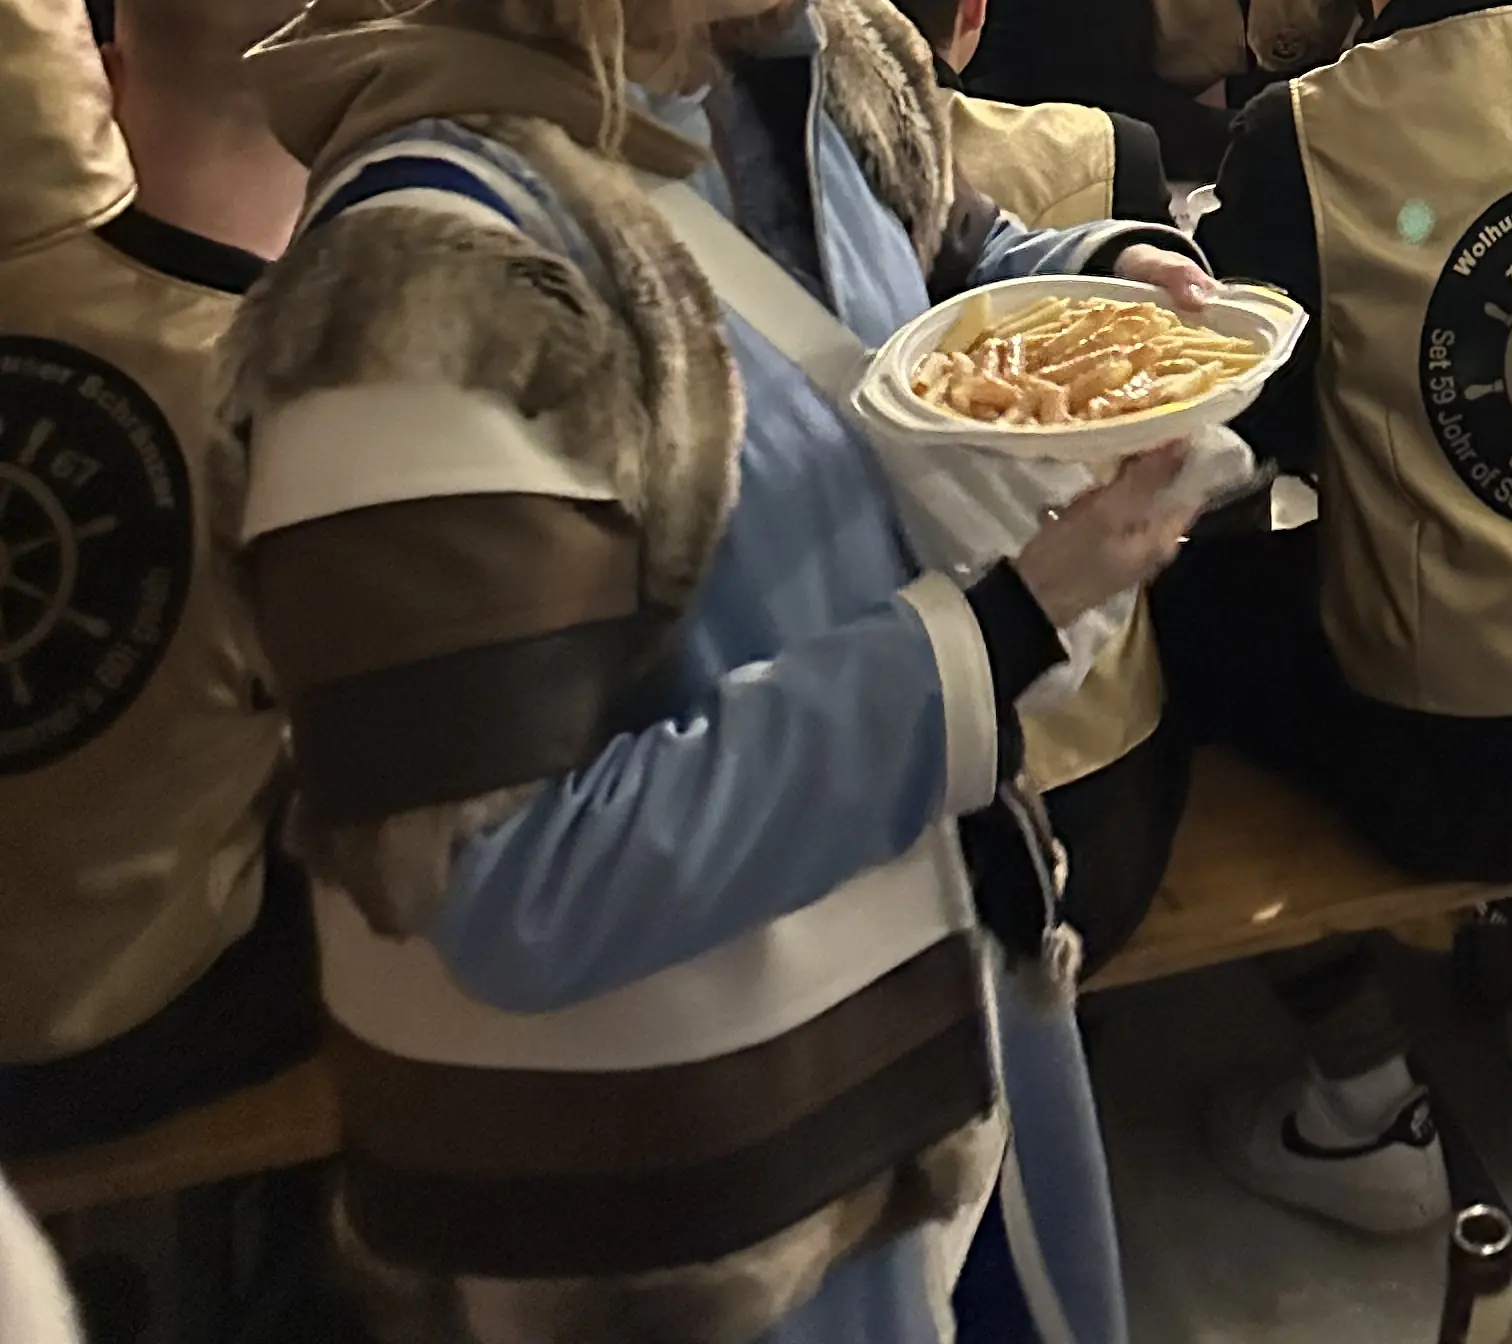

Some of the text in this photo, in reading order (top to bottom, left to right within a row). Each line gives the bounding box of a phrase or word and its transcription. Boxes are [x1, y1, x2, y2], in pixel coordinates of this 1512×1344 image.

[1429, 328, 1455, 370] Set
[1430, 376, 1457, 405] 59
[1438, 411, 1477, 461] Johr
[1471, 463, 1502, 489] of
